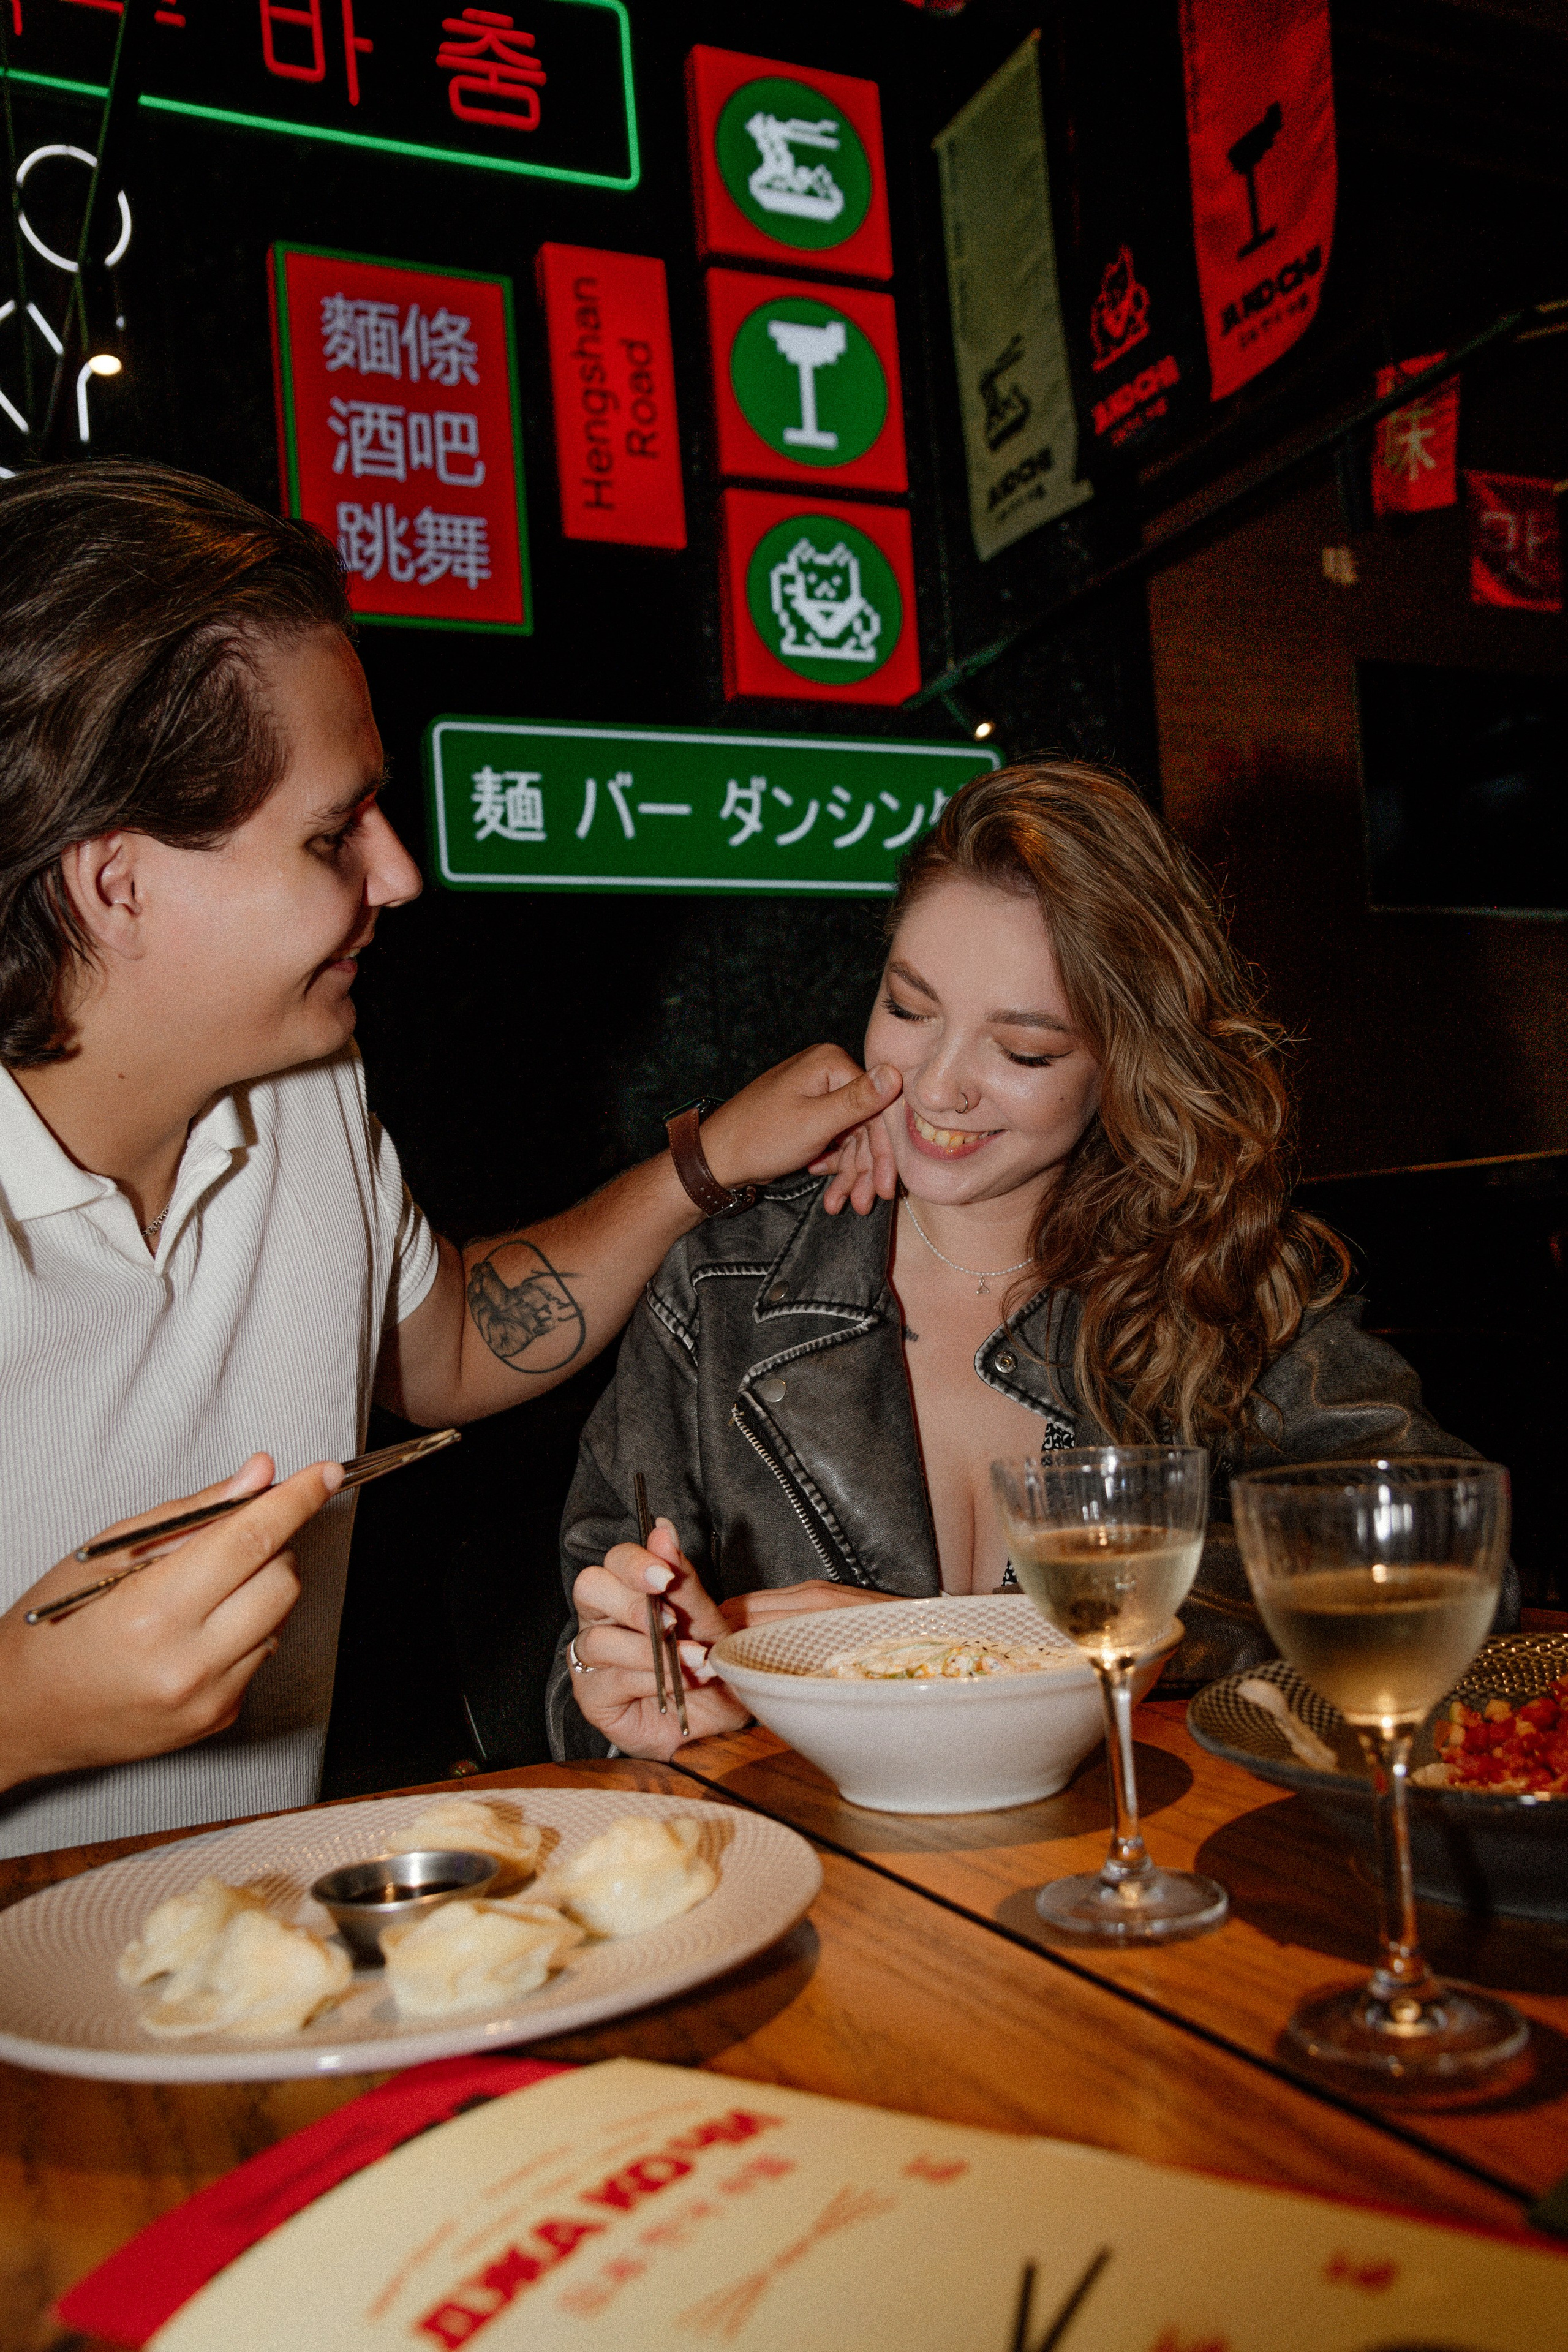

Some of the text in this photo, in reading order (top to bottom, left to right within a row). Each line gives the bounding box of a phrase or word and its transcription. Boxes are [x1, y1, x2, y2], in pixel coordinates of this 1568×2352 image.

[436, 8, 547, 131] 춤
[320, 292, 481, 388] 麵條
[572, 276, 620, 511] Hengshan
[619, 338, 660, 459] Road
[326, 396, 487, 488] 酒吧
[336, 501, 492, 590] 跳舞
[470, 764, 548, 842] 麺
[575, 770, 692, 839] バー
